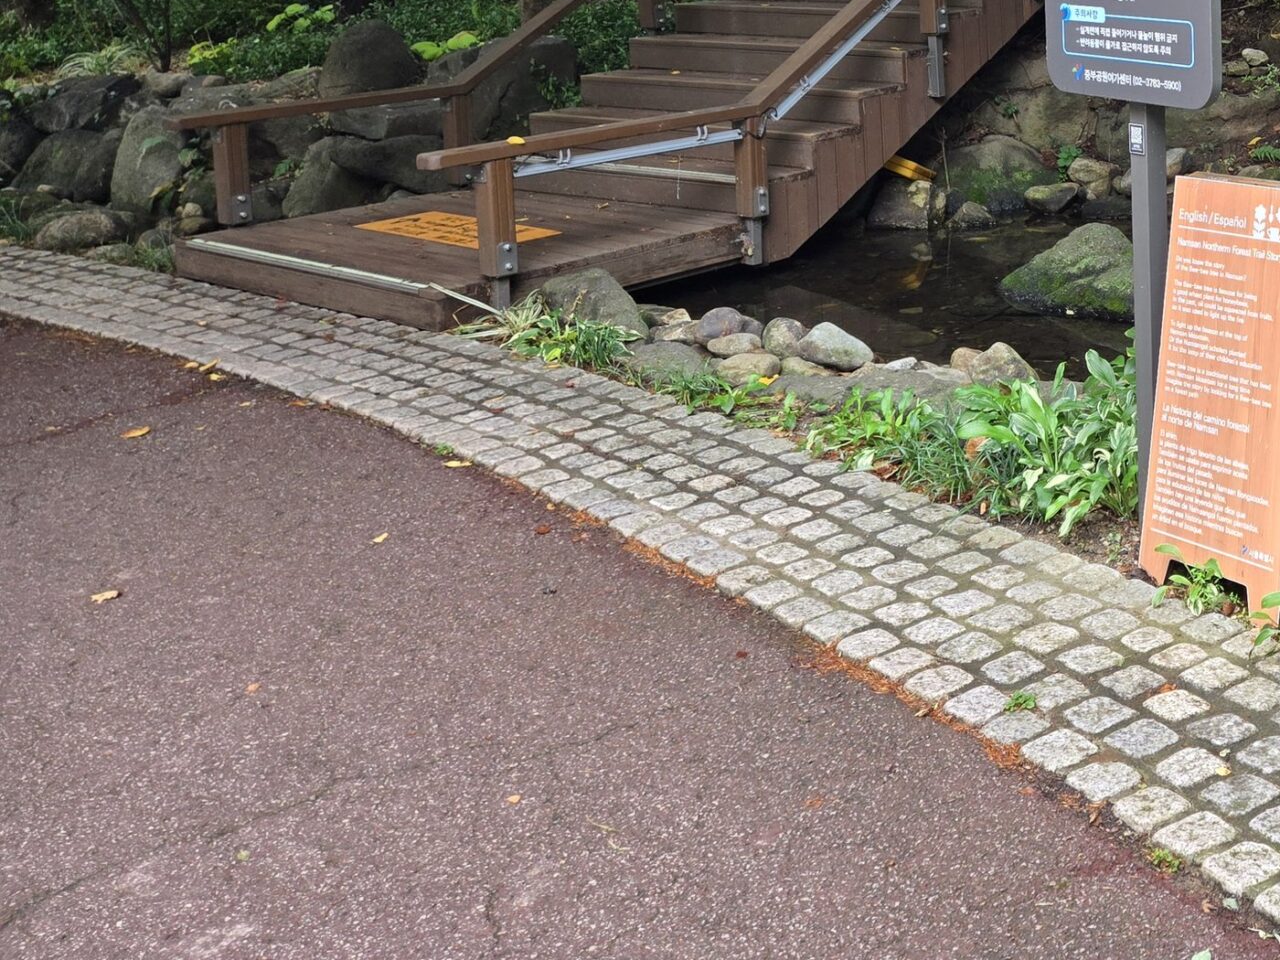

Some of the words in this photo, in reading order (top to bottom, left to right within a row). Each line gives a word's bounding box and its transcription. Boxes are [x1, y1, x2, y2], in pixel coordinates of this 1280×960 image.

[1075, 8, 1098, 20] 주의사항
[1178, 208, 1208, 223] English
[1213, 212, 1247, 228] Español
